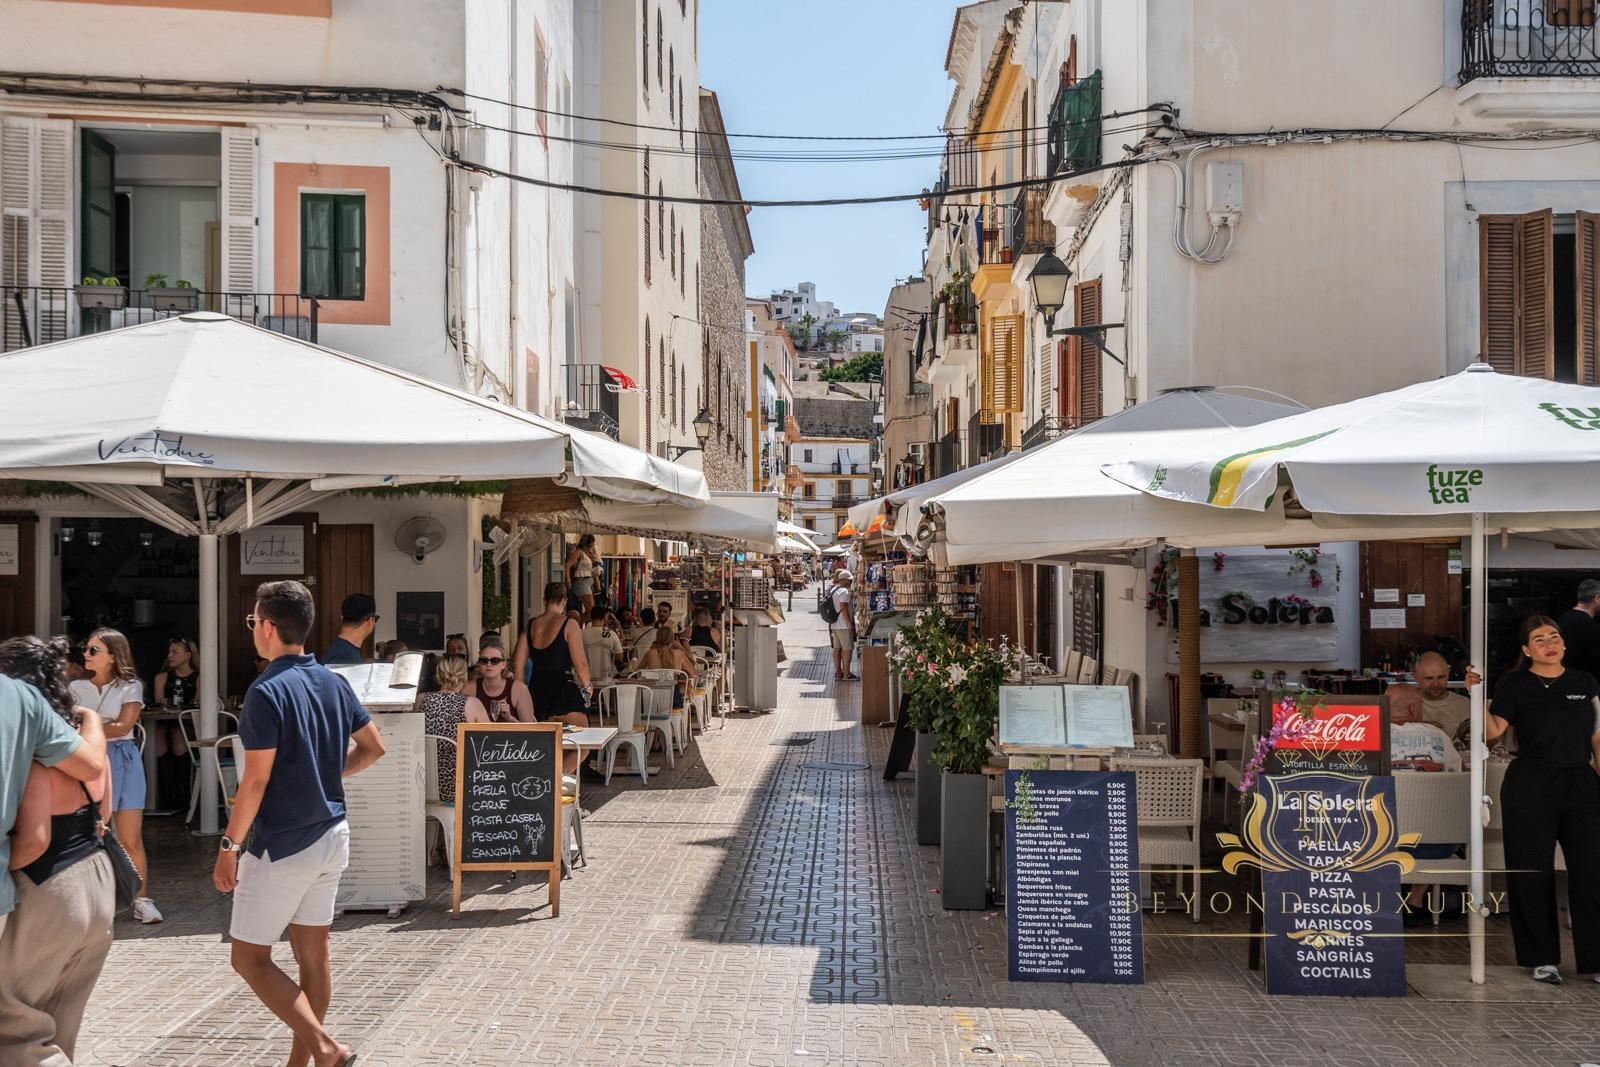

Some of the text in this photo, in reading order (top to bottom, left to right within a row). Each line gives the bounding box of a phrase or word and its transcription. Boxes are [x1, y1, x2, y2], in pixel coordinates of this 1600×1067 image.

[98, 433, 214, 461] Ventidue
[1426, 464, 1483, 488] fuze
[1428, 487, 1470, 504] tea
[470, 736, 546, 767] Ventidue
[473, 785, 506, 796] PAELLA
[472, 800, 510, 810] CARNE
[1278, 794, 1377, 810] La Solera
[471, 813, 543, 826] PASTA CASERA
[472, 830, 518, 842] PESCADO
[1298, 840, 1360, 851] PAELLAS
[1306, 856, 1354, 867] TAPAS
[1310, 872, 1352, 882] PIZZA
[1309, 888, 1355, 898] PASTA
[1294, 903, 1372, 915] PESCADOS
[1295, 919, 1372, 930] MARISCOS
[1305, 936, 1364, 946] CRNES
[1297, 948, 1374, 962] SANGRÍAS
[1300, 966, 1371, 979] COCTAILS
